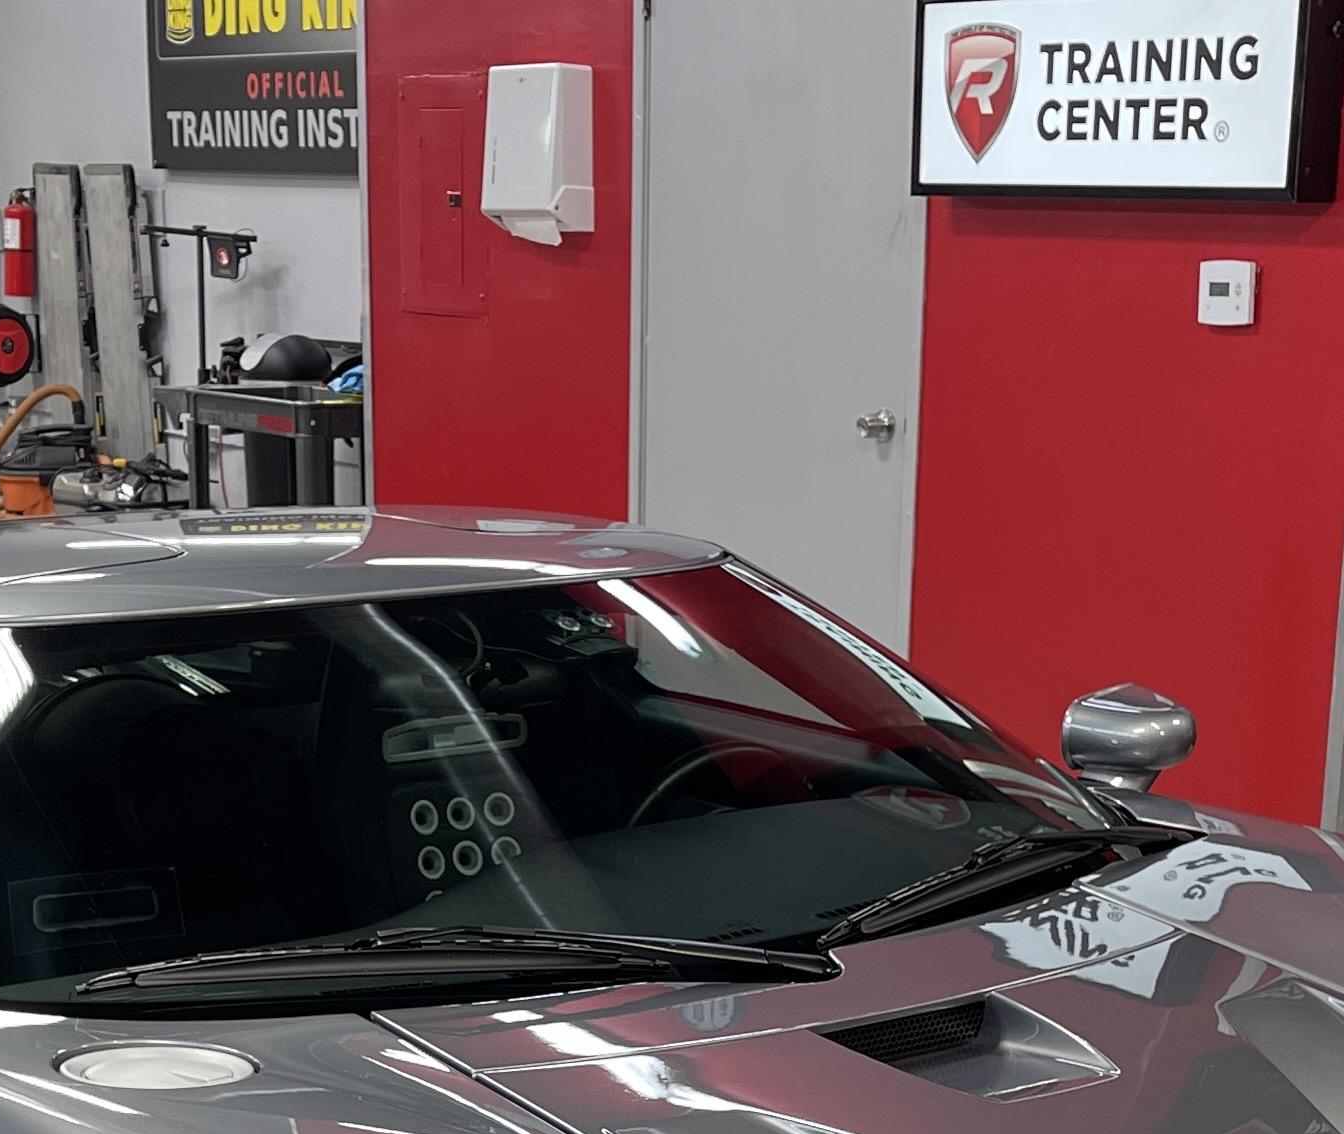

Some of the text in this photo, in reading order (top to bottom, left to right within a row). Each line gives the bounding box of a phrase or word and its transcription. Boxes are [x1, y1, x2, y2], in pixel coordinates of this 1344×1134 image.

[203, 0, 287, 36] DING
[1039, 35, 1259, 84] TRAINING
[246, 69, 345, 99] OFFICIAL
[166, 107, 358, 148] TRAINING INST
[1037, 97, 1209, 141] CENTER
